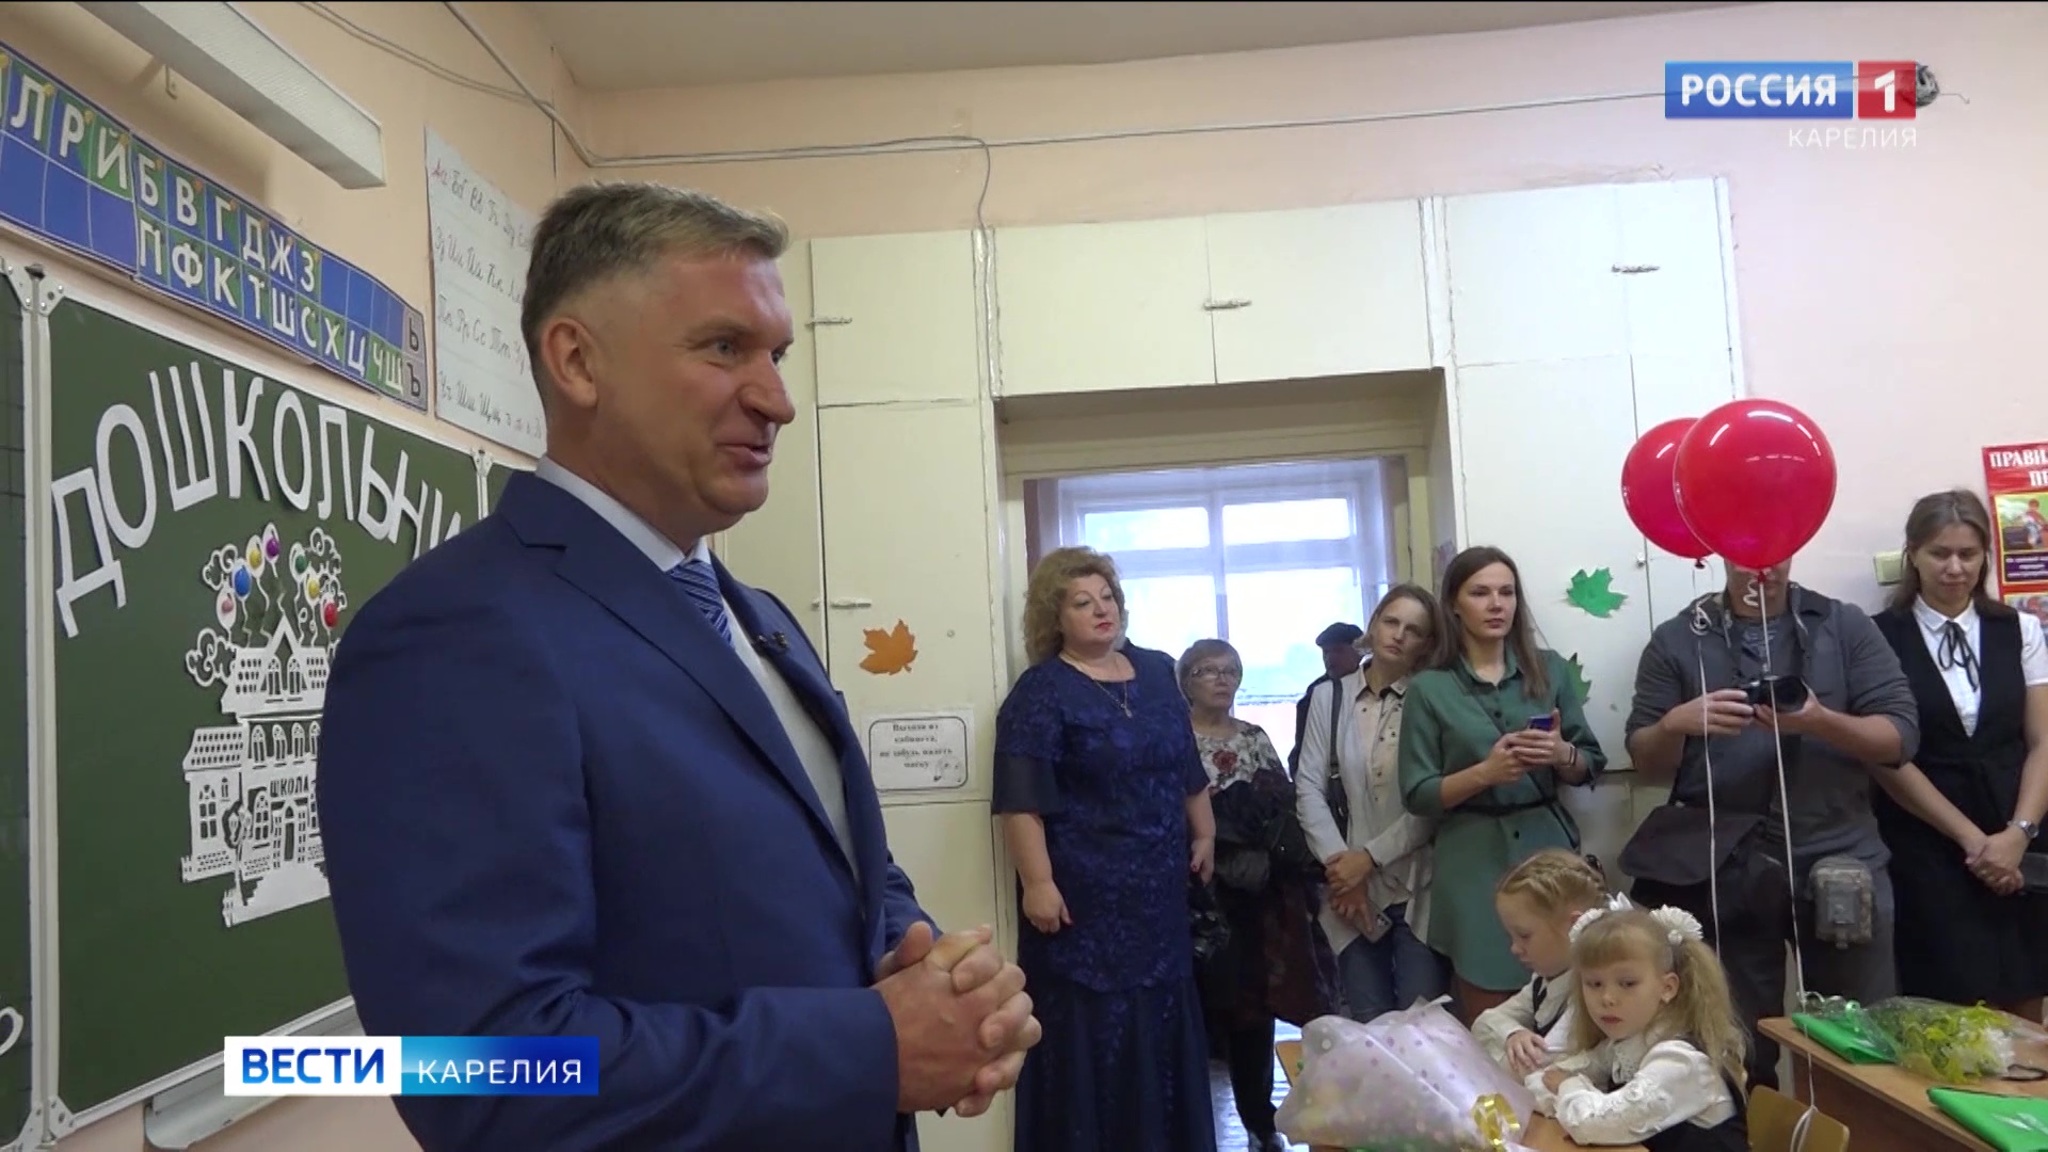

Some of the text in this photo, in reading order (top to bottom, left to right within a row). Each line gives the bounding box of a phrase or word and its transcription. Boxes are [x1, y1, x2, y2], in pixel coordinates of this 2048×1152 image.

[10, 74, 314, 292] Л Р Й Б В Г Д Ж З
[139, 219, 404, 396] П Ф К Т Ш С Х Ц Ч Щ
[270, 775, 309, 798] ШКОЛА
